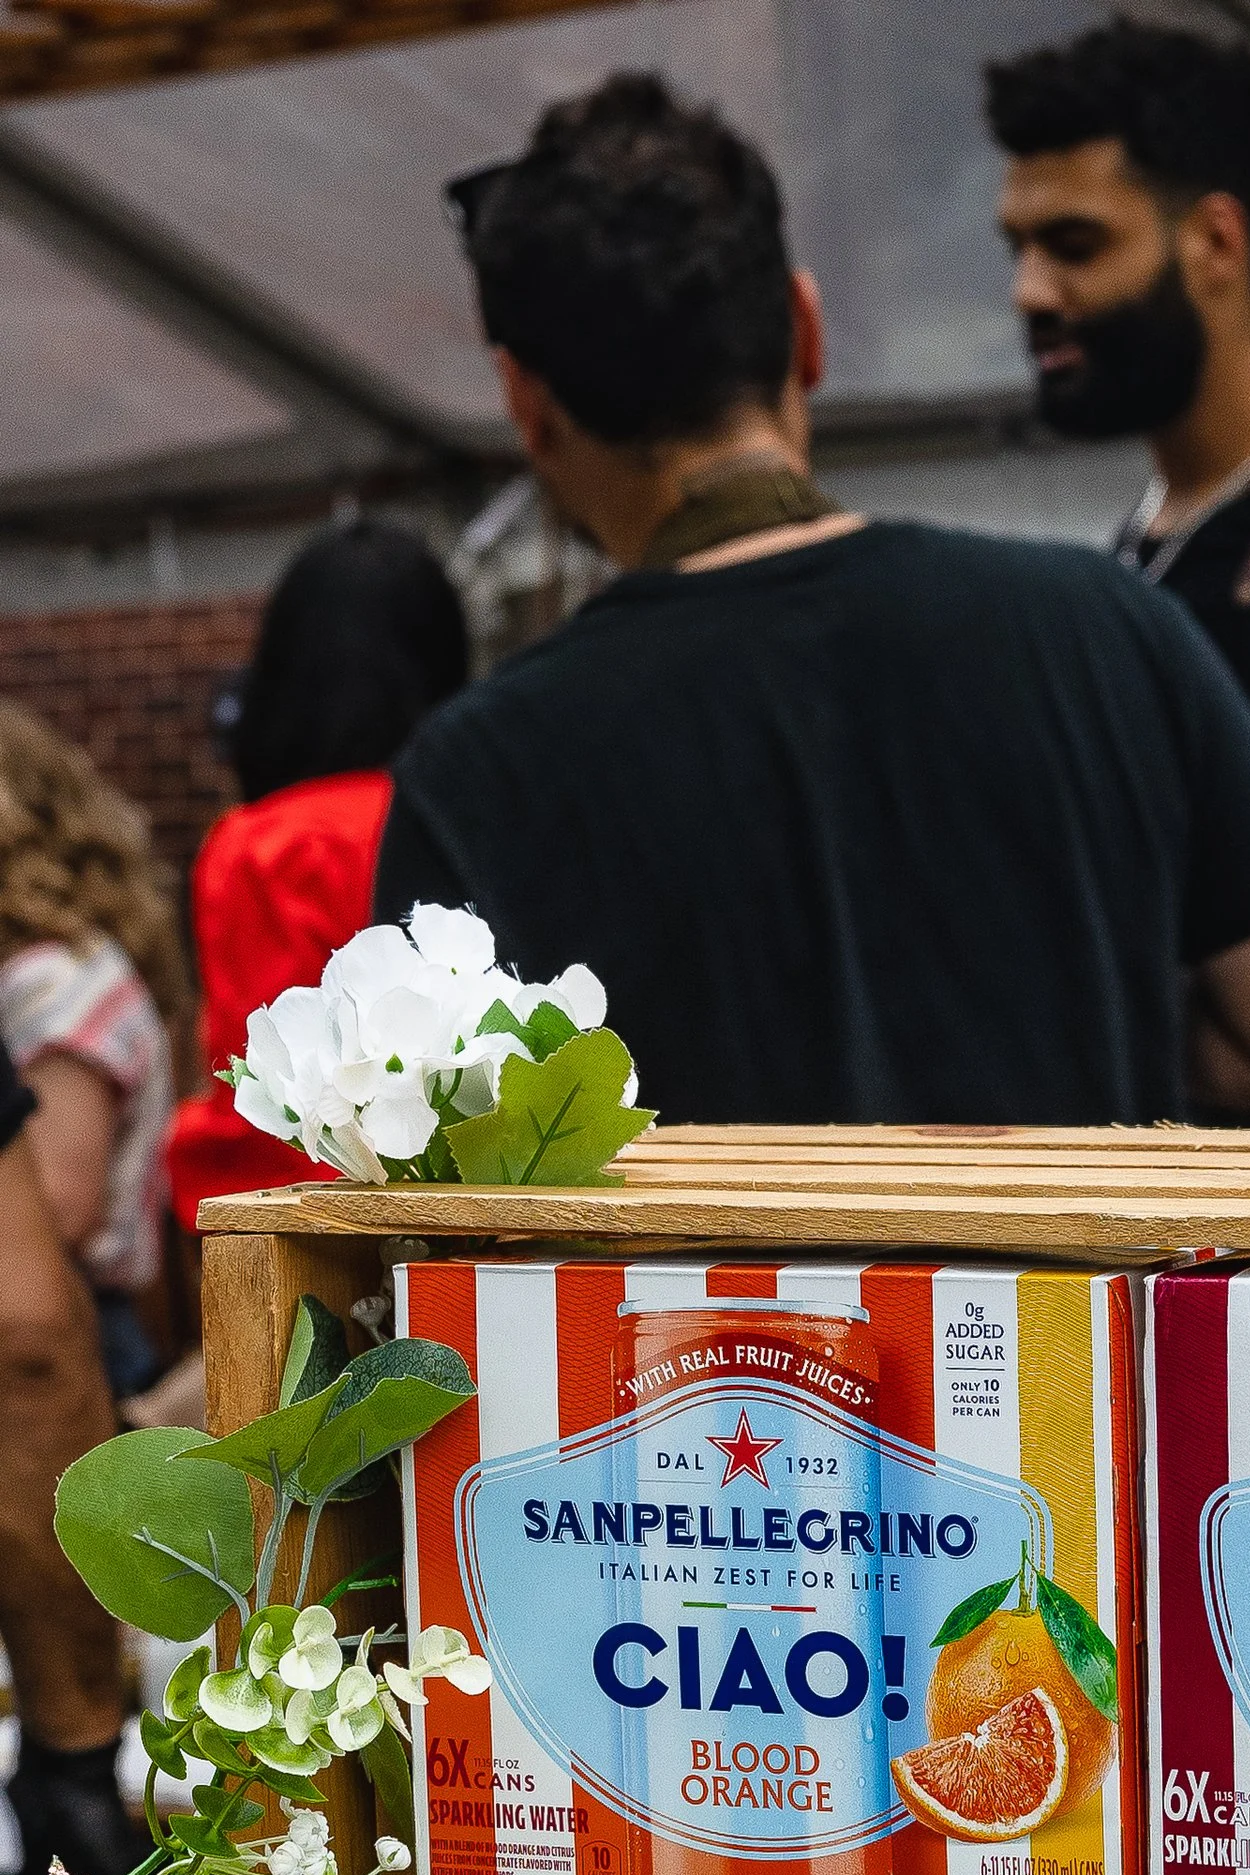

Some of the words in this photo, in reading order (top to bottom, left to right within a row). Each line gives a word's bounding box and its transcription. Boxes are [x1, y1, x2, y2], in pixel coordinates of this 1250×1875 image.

[965, 1302, 985, 1322] 0g
[945, 1323, 1005, 1339] ADDED
[946, 1344, 1006, 1361] SUGAR
[625, 1360, 677, 1397] WITH
[679, 1346, 730, 1373] REAL
[735, 1345, 794, 1372] FRUIT
[796, 1359, 866, 1405] JUICES
[951, 1382, 981, 1391] ONLY
[984, 1379, 1000, 1392] 10
[952, 1395, 1000, 1404] CALORIES
[952, 1407, 973, 1416] PER
[976, 1408, 1000, 1417] CAN
[657, 1452, 705, 1471] DAL
[786, 1456, 839, 1475] 1932
[599, 1562, 698, 1585] ITALIAN
[713, 1567, 772, 1588] ZEST
[788, 1571, 835, 1590] FOR
[850, 1573, 901, 1592] LIFE
[592, 1622, 910, 1722] CIAO!
[427, 1737, 472, 1788] 6X
[494, 1759, 504, 1768] FL
[505, 1759, 520, 1769] OZ
[690, 1739, 821, 1777] BLOOD
[473, 1772, 535, 1792] CANS
[681, 1775, 834, 1812] ORANGE
[1163, 1768, 1211, 1824] 6X
[430, 1799, 525, 1830] SPARKLING
[529, 1805, 590, 1833] WATER
[508, 1844, 535, 1855] ORANGE
[536, 1845, 550, 1856] AND
[552, 1846, 574, 1858] CITRUS
[592, 1846, 610, 1870] 10
[519, 1858, 552, 1870] FLAVORED
[553, 1860, 572, 1871] WITH
